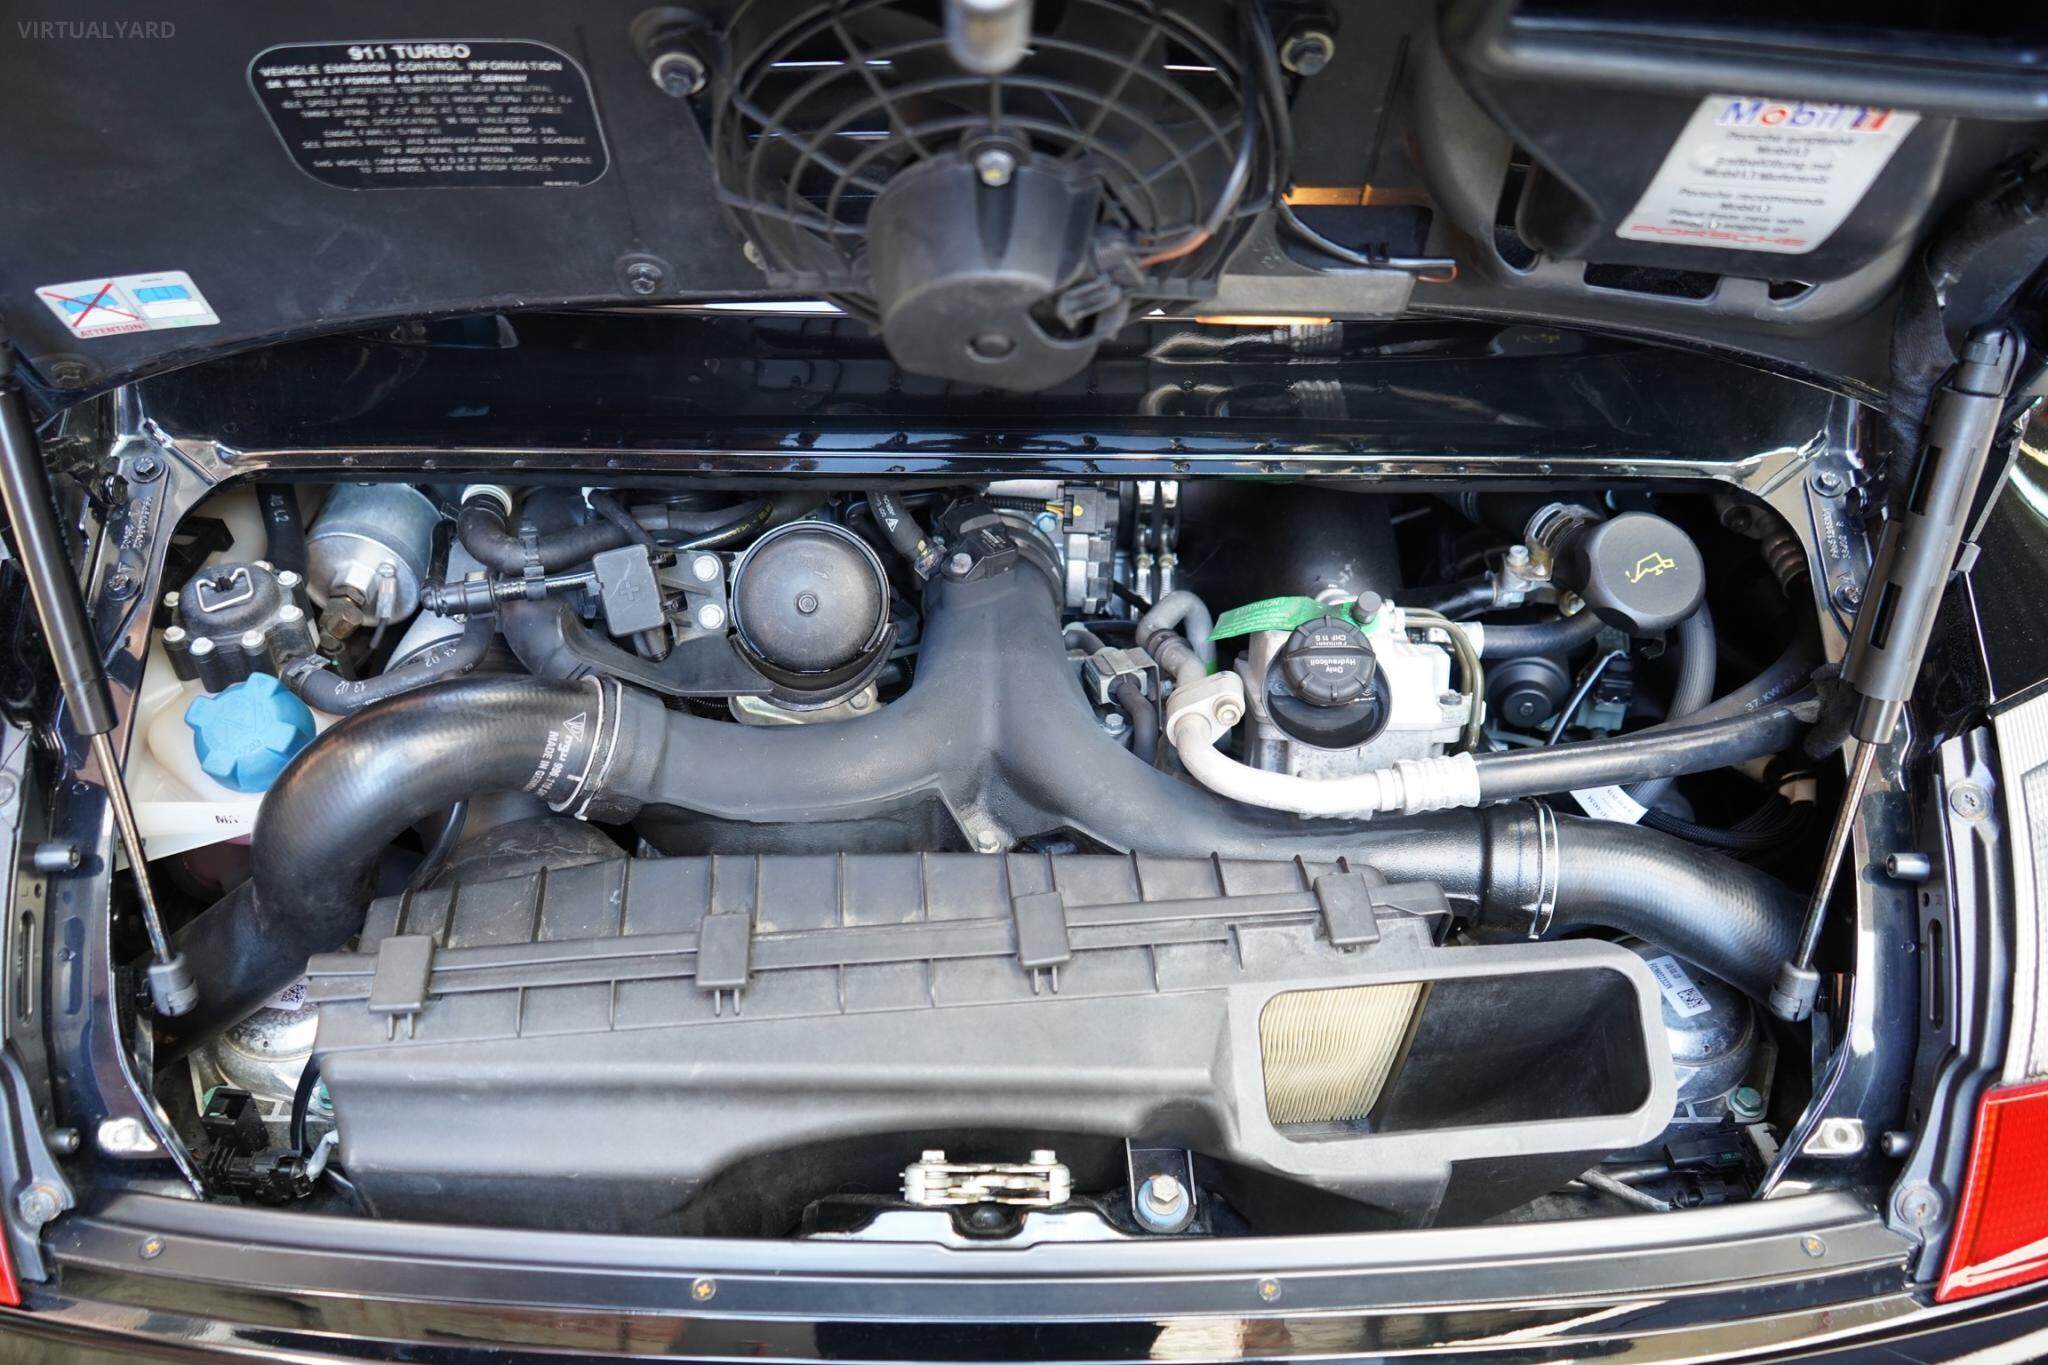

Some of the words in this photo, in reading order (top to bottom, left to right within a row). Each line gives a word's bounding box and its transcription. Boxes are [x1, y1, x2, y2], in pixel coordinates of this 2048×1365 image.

[347, 45, 387, 60] 911
[390, 44, 471, 59] TURBO
[258, 64, 320, 77] VEHICLE
[322, 62, 391, 74] EMISSION
[394, 61, 464, 72] CONTROL
[466, 60, 563, 71] INFORMATION
[412, 74, 473, 83] STUTTGART
[1719, 99, 1845, 127] Mobil
[1630, 223, 1808, 247] PORSCHE
[1325, 665, 1344, 674] Only
[543, 730, 560, 761] MADE
